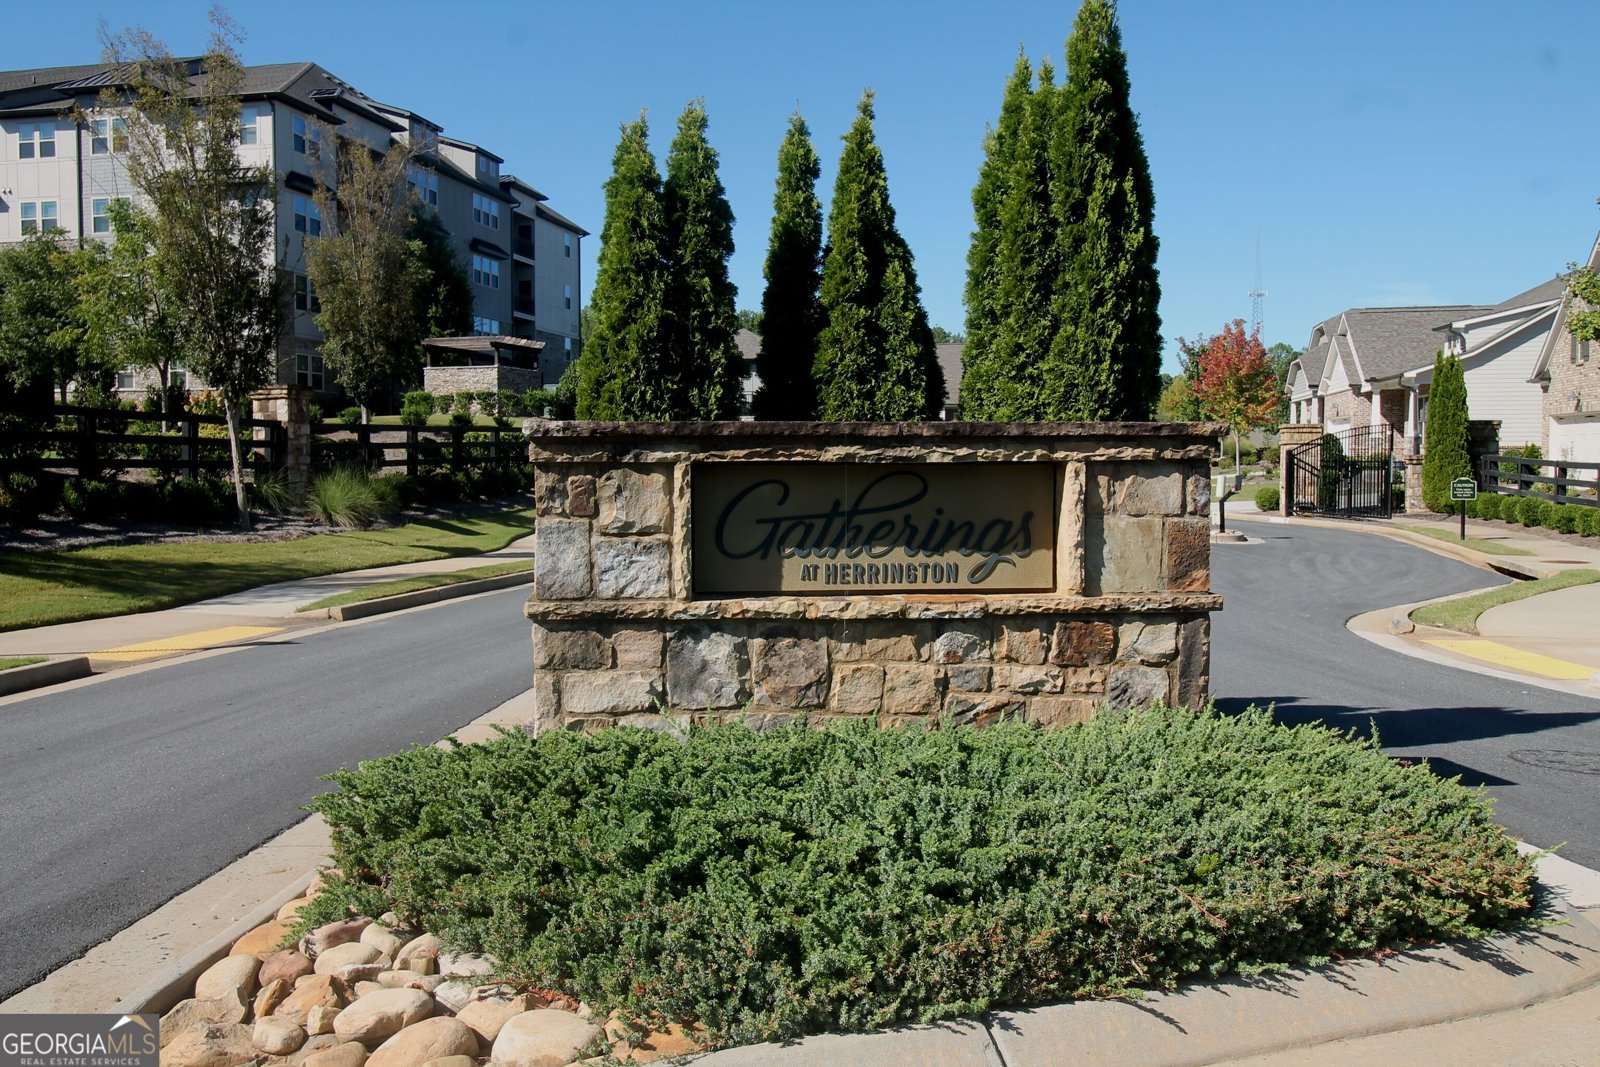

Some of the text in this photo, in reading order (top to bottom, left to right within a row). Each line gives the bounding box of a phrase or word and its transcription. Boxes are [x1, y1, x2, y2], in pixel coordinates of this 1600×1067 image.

[714, 470, 1034, 584] Gatherings
[800, 562, 959, 585] AT HERRINGTON
